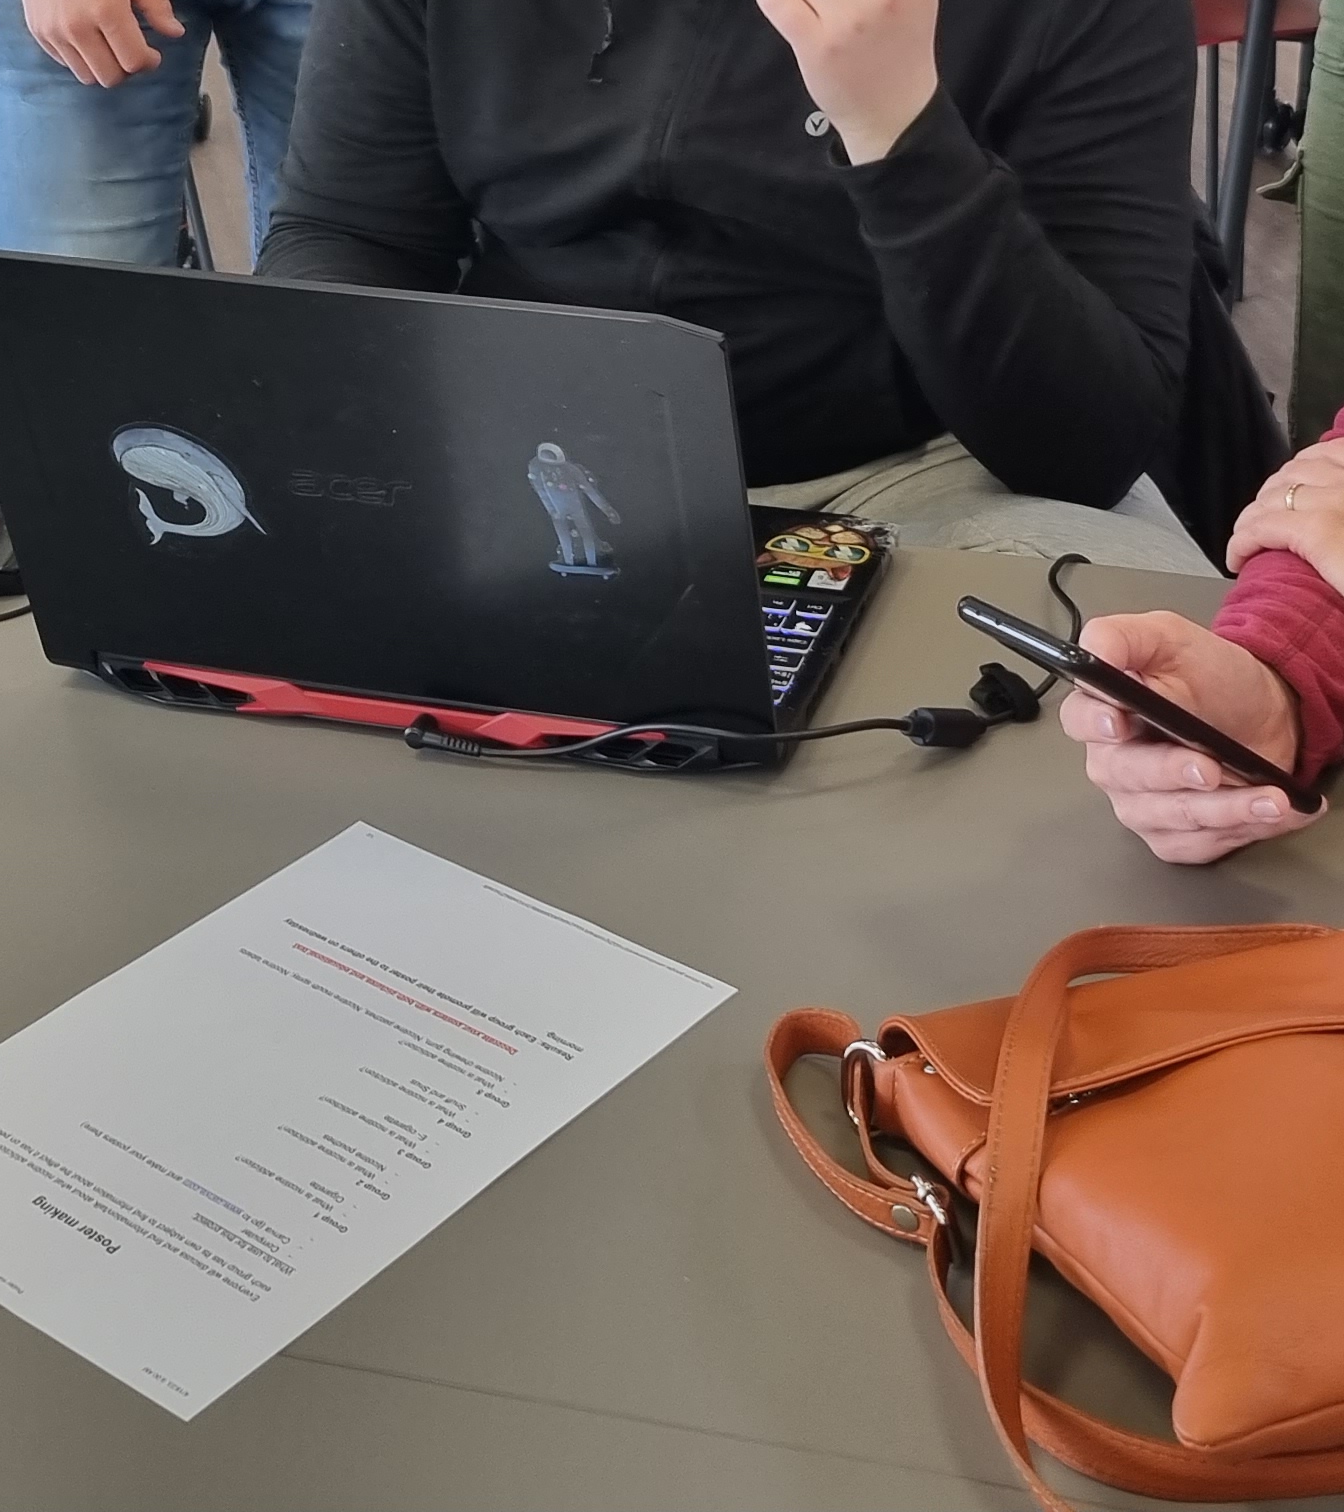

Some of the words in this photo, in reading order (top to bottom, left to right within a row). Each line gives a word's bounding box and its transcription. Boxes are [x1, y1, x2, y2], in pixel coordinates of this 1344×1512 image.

[286, 468, 413, 507] acer
[284, 918, 328, 942] wednesday
[292, 942, 311, 954] text
[339, 944, 366, 959] others
[261, 959, 290, 976] Nicotine
[306, 949, 353, 973] educational
[348, 969, 369, 981] and
[388, 969, 418, 985] poster
[310, 983, 334, 997] mouth
[365, 976, 400, 996] pictures
[415, 982, 437, 995] their
[333, 994, 363, 1012] Nicotine
[396, 992, 418, 1006] both
[414, 1000, 435, 1013] with
[436, 991, 474, 1011] promote
[431, 1009, 466, 1028] posters
[487, 1016, 516, 1032] group
[392, 1024, 424, 1042] Nicotine
[461, 1024, 484, 1037] your
[514, 1029, 538, 1044] Each
[397, 1040, 439, 1060] addiction?
[480, 1033, 519, 1056] Decorate
[437, 1057, 467, 1075] nicotine
[442, 1047, 475, 1067] chewing
[358, 1066, 399, 1088] addiction?
[473, 1075, 495, 1090] What
[474, 1064, 506, 1083] Nicotine
[398, 1085, 429, 1103] nicotine
[409, 1078, 431, 1093] Snus
[318, 1096, 359, 1117] addiction?
[443, 1098, 467, 1111] Snuff
[483, 1092, 511, 1109] Group
[434, 1104, 457, 1119] What
[358, 1114, 389, 1133] nicotine
[383, 1114, 418, 1135] cigarette
[444, 1121, 472, 1139] Group
[102, 1134, 131, 1152] posters
[277, 1125, 319, 1147] addiction?
[322, 1133, 357, 1154] pouches
[394, 1134, 417, 1150] What
[19, 1142, 35, 1155] has
[128, 1149, 148, 1161] your
[317, 1144, 347, 1163] nicotine
[38, 1154, 61, 1169] effect
[145, 1159, 168, 1174] make
[234, 1155, 276, 1178] addiction?
[354, 1151, 387, 1173] Nicotine
[404, 1152, 432, 1170] Group
[26, 1161, 56, 1180] nicotine
[165, 1170, 184, 1182] and
[354, 1164, 376, 1180] What
[52, 1177, 73, 1191] what
[70, 1172, 95, 1188] about
[274, 1176, 305, 1195] nicotine
[70, 1187, 95, 1203] about
[92, 1185, 134, 1212] information
[309, 1181, 345, 1204] Cigarette
[363, 1183, 391, 1201] Group
[31, 1195, 80, 1228] making
[311, 1196, 334, 1213] What
[131, 1209, 149, 1222] find
[320, 1215, 349, 1234] Group
[76, 1225, 122, 1255] Poster
[146, 1233, 165, 1246] find
[155, 1222, 186, 1242] subject
[220, 1228, 240, 1243] this
[240, 1228, 280, 1254] Computer
[264, 1226, 291, 1245] Canva
[161, 1241, 181, 1254] and
[183, 1239, 203, 1251] own
[234, 1236, 252, 1249] for
[246, 1243, 267, 1257] use
[178, 1251, 210, 1271] discuss
[211, 1255, 228, 1268] has
[262, 1252, 276, 1264] to
[270, 1257, 297, 1276] What
[226, 1264, 254, 1281] group
[221, 1276, 261, 1303] Everyone
[250, 1278, 272, 1293] each
